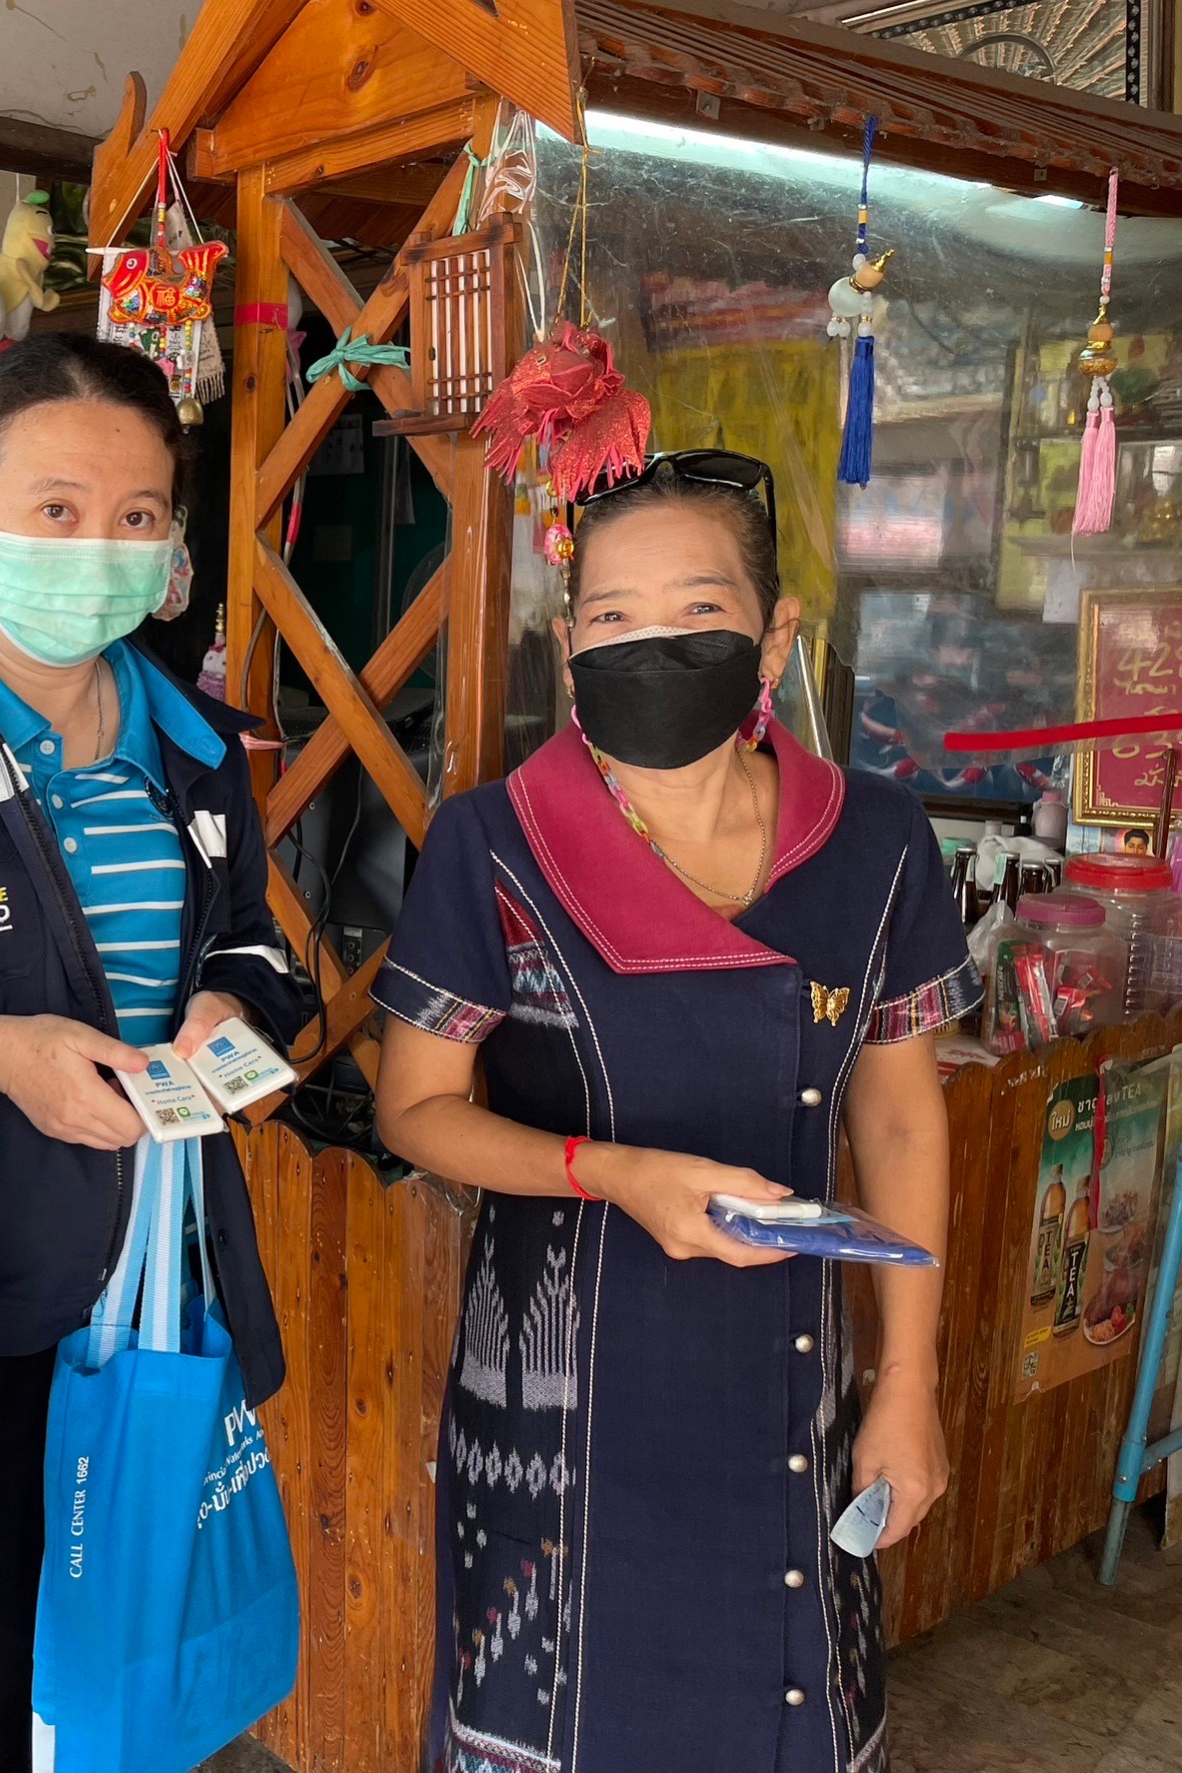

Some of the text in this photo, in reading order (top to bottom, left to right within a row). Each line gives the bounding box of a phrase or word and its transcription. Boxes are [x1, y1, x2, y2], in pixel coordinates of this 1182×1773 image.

[1121, 1082, 1142, 1101] TEA
[1050, 1109, 1072, 1131] ใหม่
[1066, 1251, 1079, 1298] TEA
[69, 1456, 89, 1578] CALL CENTER 1662
